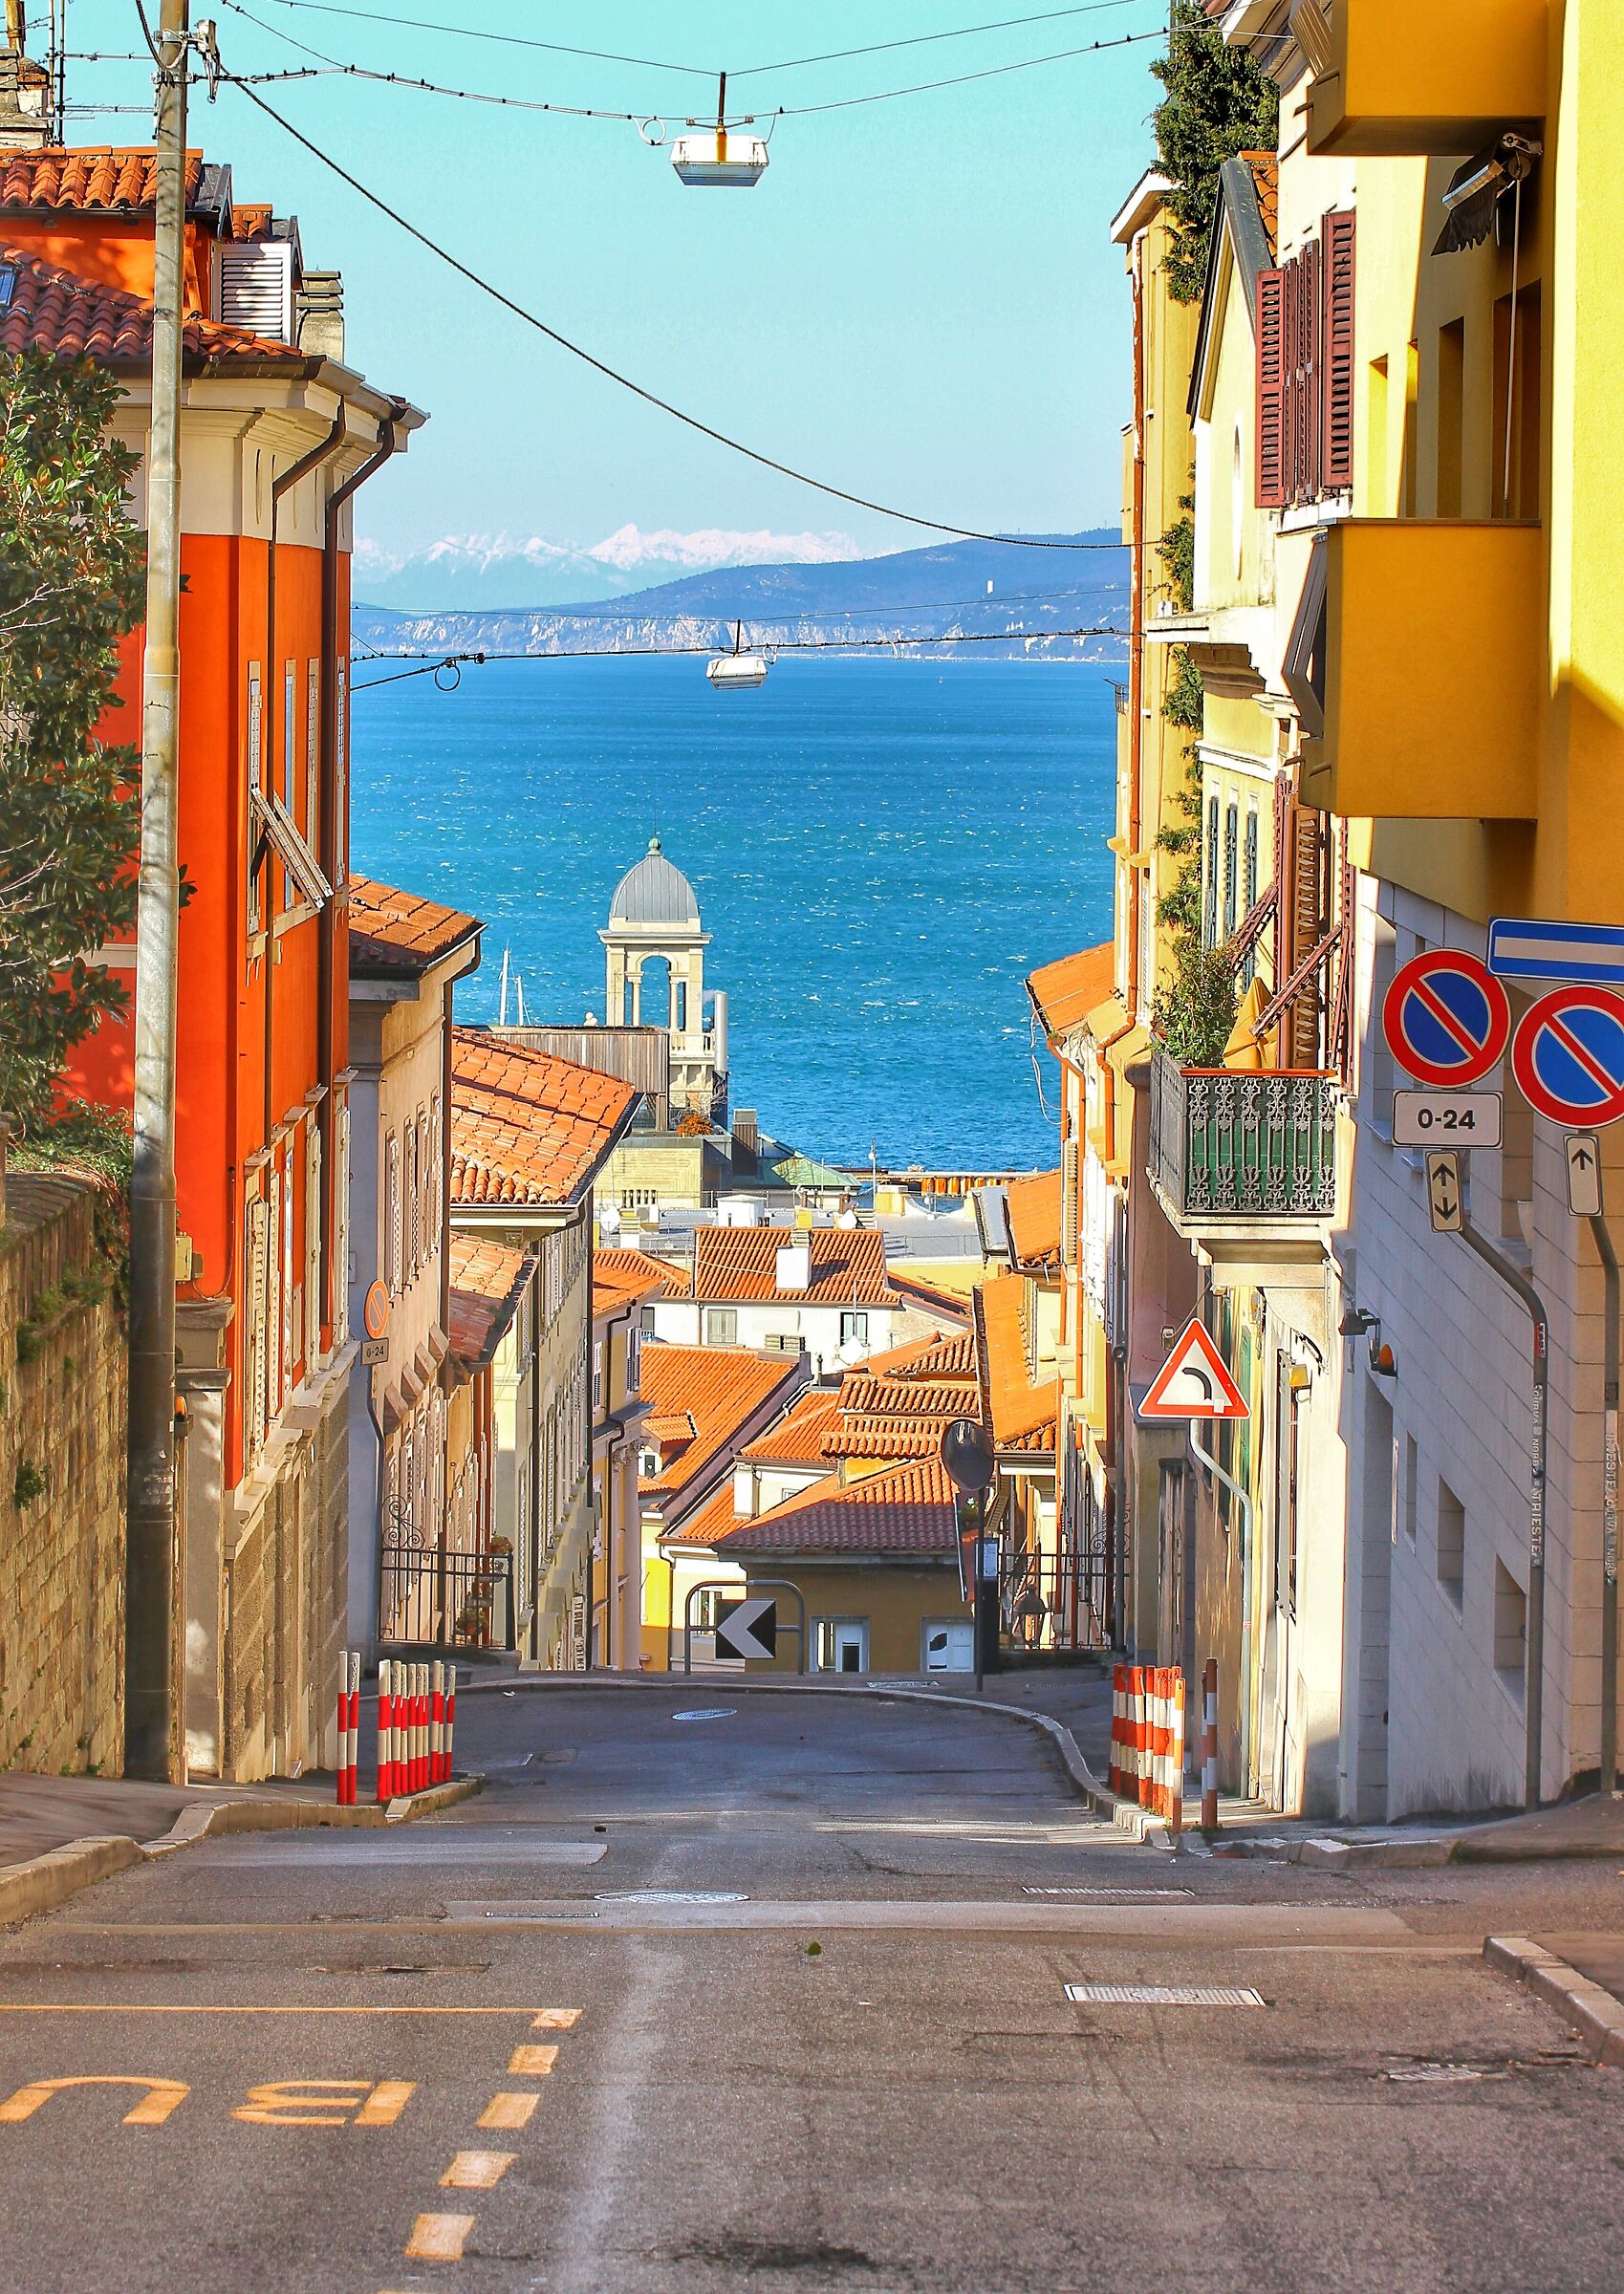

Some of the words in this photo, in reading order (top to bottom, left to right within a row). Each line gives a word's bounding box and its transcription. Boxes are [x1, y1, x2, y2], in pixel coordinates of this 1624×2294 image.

[1418, 1109, 1476, 1130] 0-24
[366, 1345, 384, 1358] 0-24
[1531, 1493, 1542, 1554] TRIESTE
